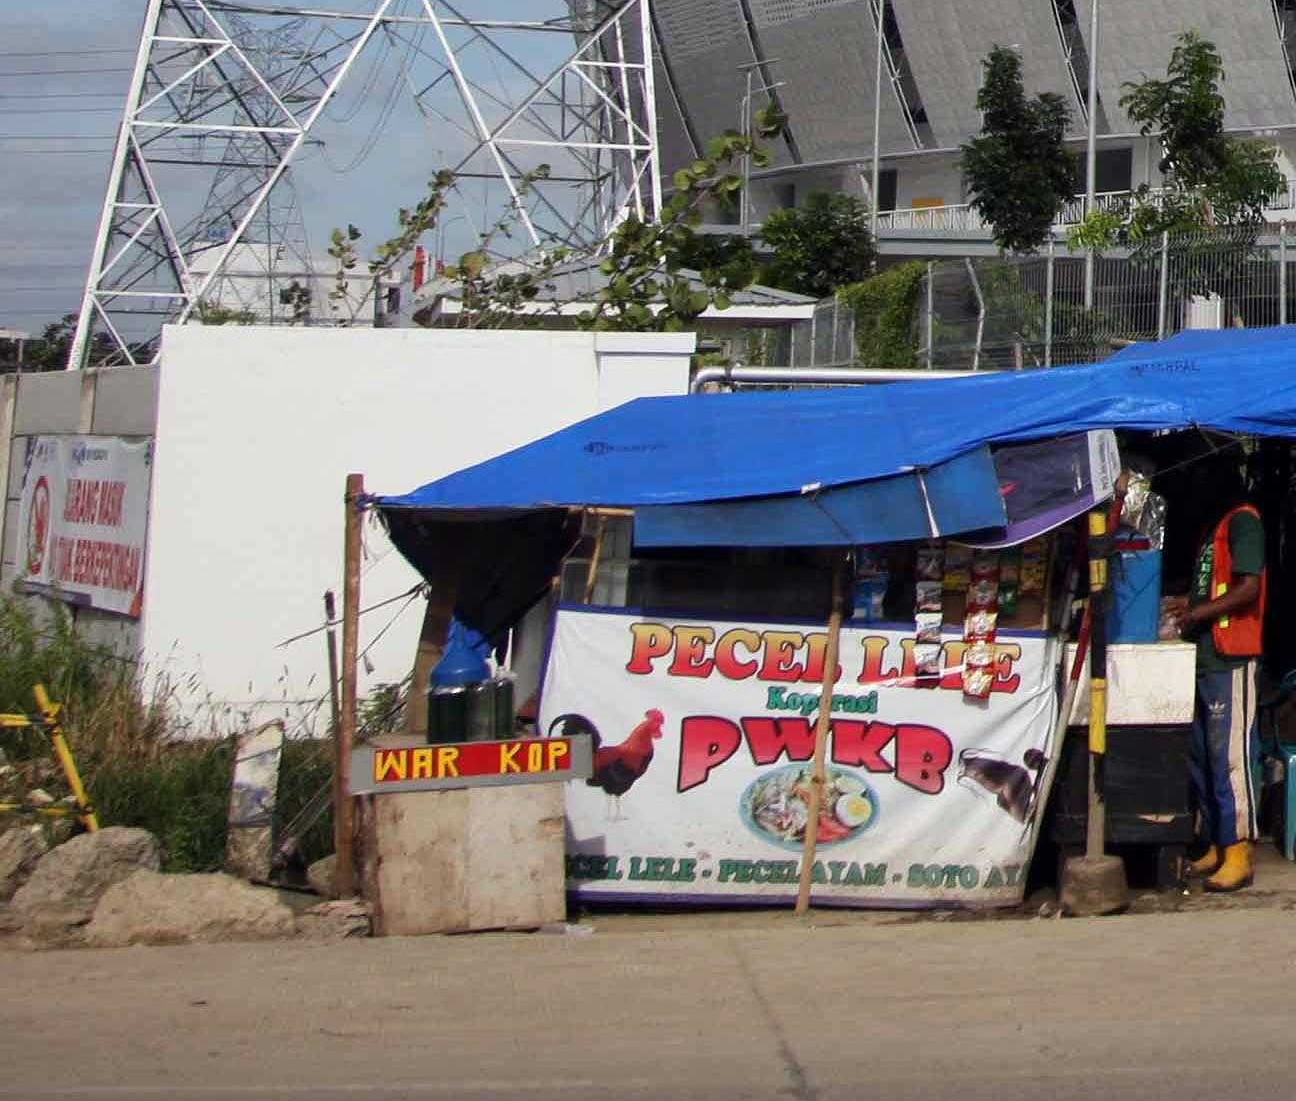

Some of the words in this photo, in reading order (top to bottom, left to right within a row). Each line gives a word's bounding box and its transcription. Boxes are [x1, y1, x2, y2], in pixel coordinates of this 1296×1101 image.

[626, 623, 841, 684] PECEL
[374, 748, 460, 782] WAR
[500, 741, 569, 775] KOP
[677, 716, 953, 795] PWKB
[628, 857, 697, 882] LELE
[718, 859, 803, 883] PECEL
[811, 860, 886, 886] AYAM
[907, 863, 980, 888] SOTO
